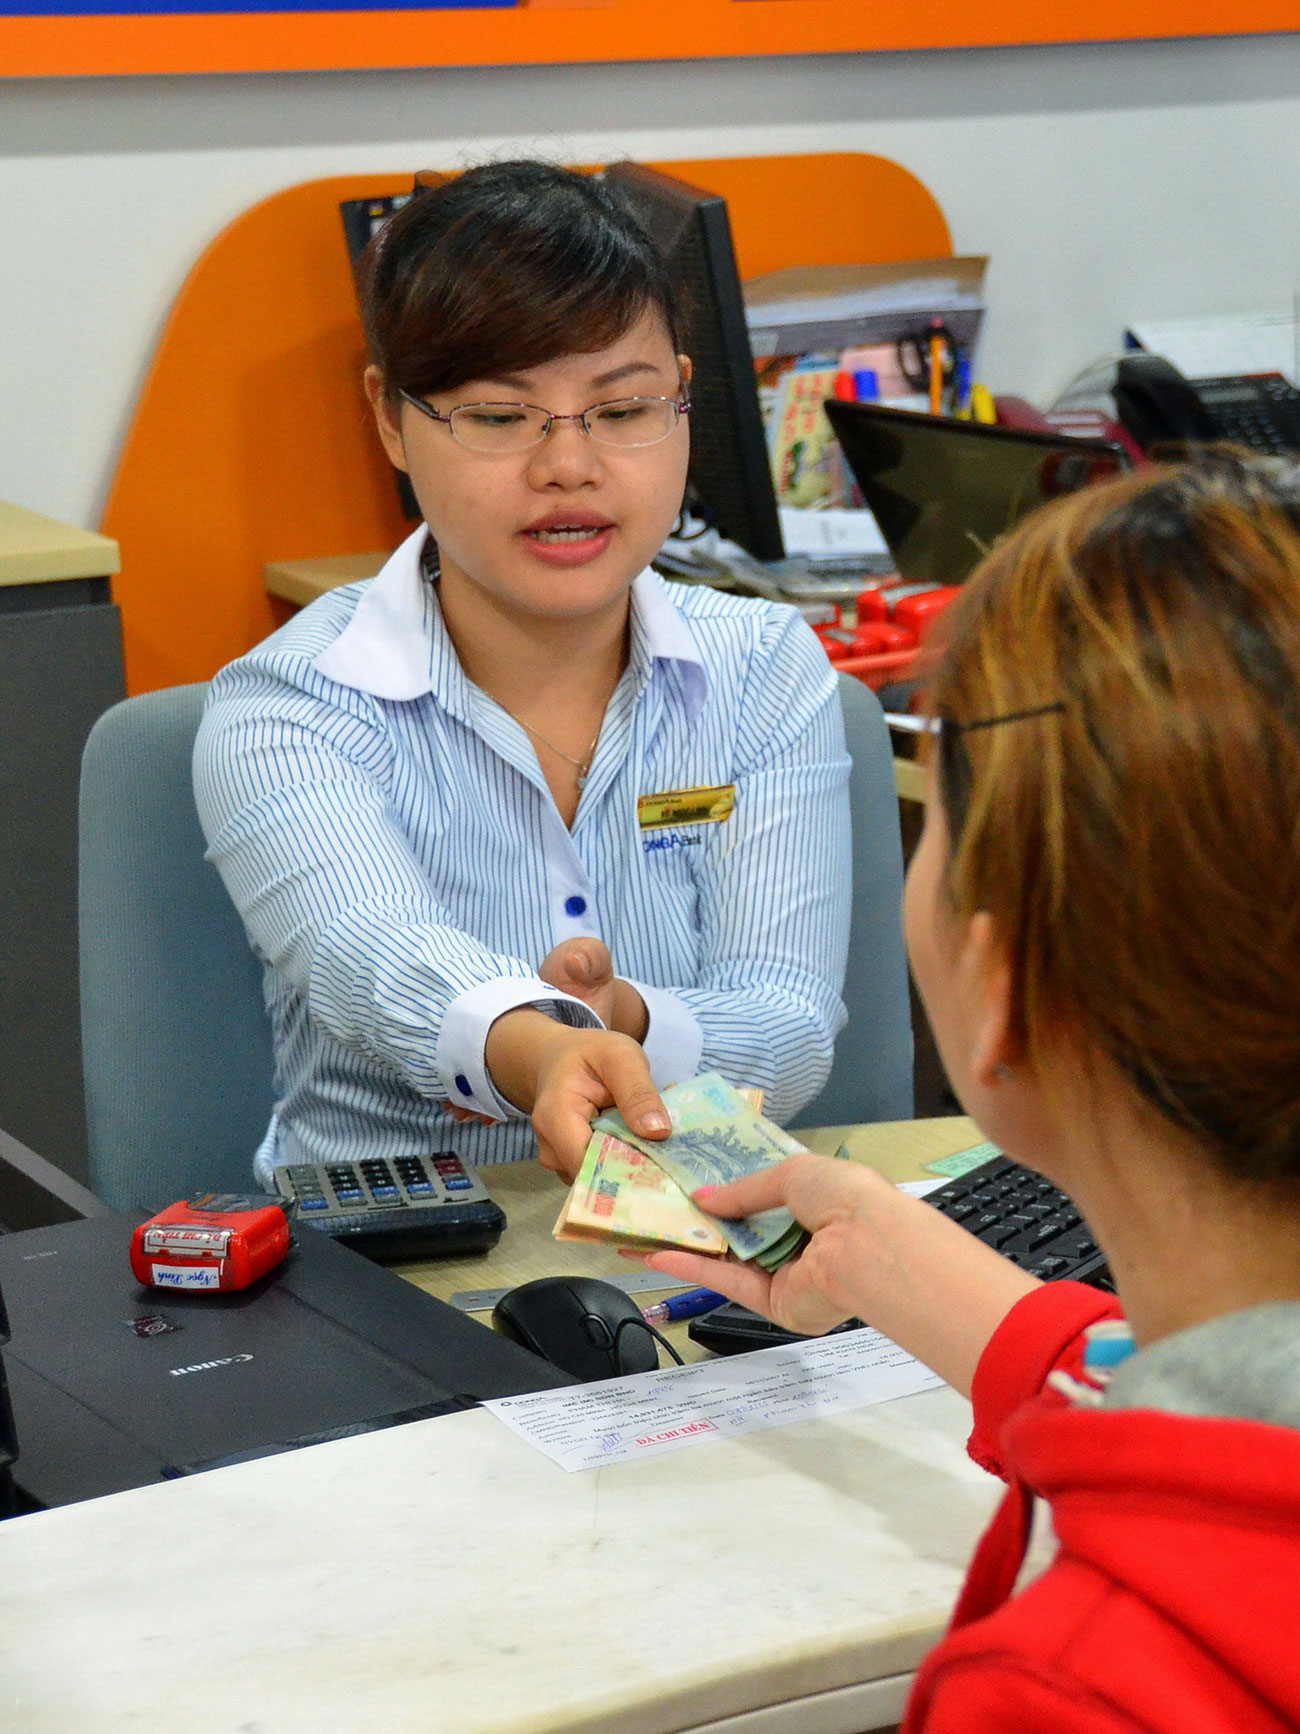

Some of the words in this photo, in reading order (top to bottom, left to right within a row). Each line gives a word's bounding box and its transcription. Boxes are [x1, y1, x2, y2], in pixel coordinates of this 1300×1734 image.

[158, 1272, 182, 1285] Linh
[187, 1270, 217, 1286] Ngọc
[169, 1353, 254, 1376] Canon
